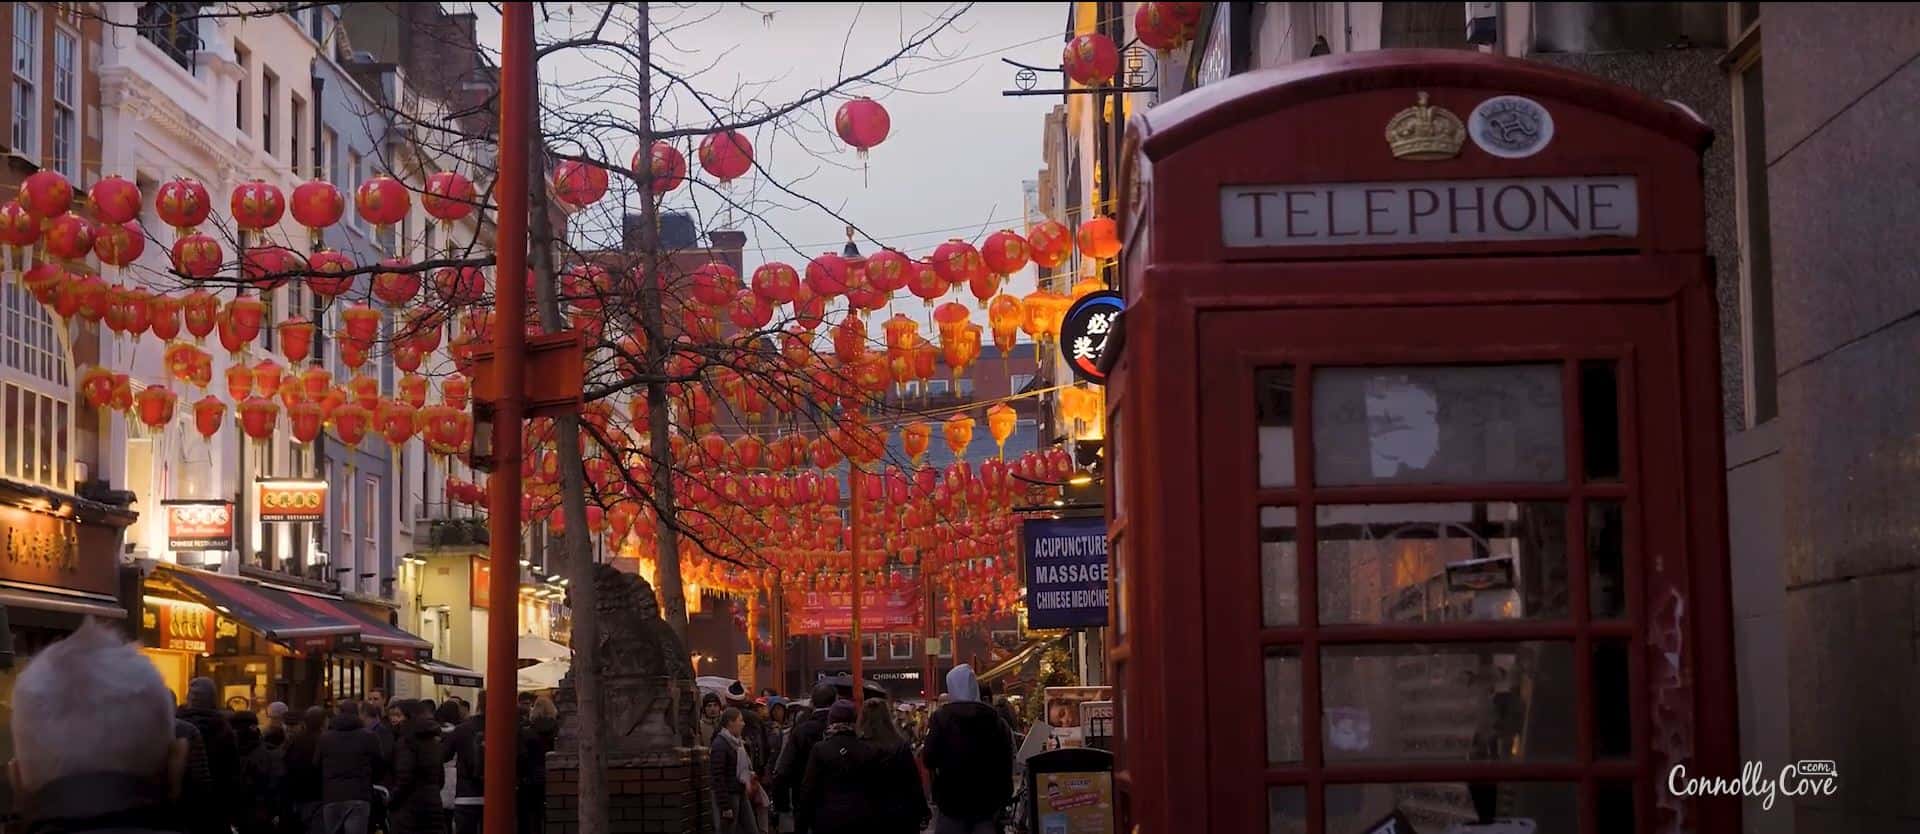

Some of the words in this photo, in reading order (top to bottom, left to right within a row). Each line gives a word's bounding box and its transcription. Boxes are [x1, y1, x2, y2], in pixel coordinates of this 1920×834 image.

[1236, 184, 1623, 238] TELEPHONE
[1035, 536, 1107, 558] ACUPUNCTURE
[1036, 564, 1109, 584] MASSAGE
[1036, 591, 1071, 610] CHINESE
[1072, 588, 1109, 609] MEDICINE
[873, 672, 920, 680] CHINATOWN
